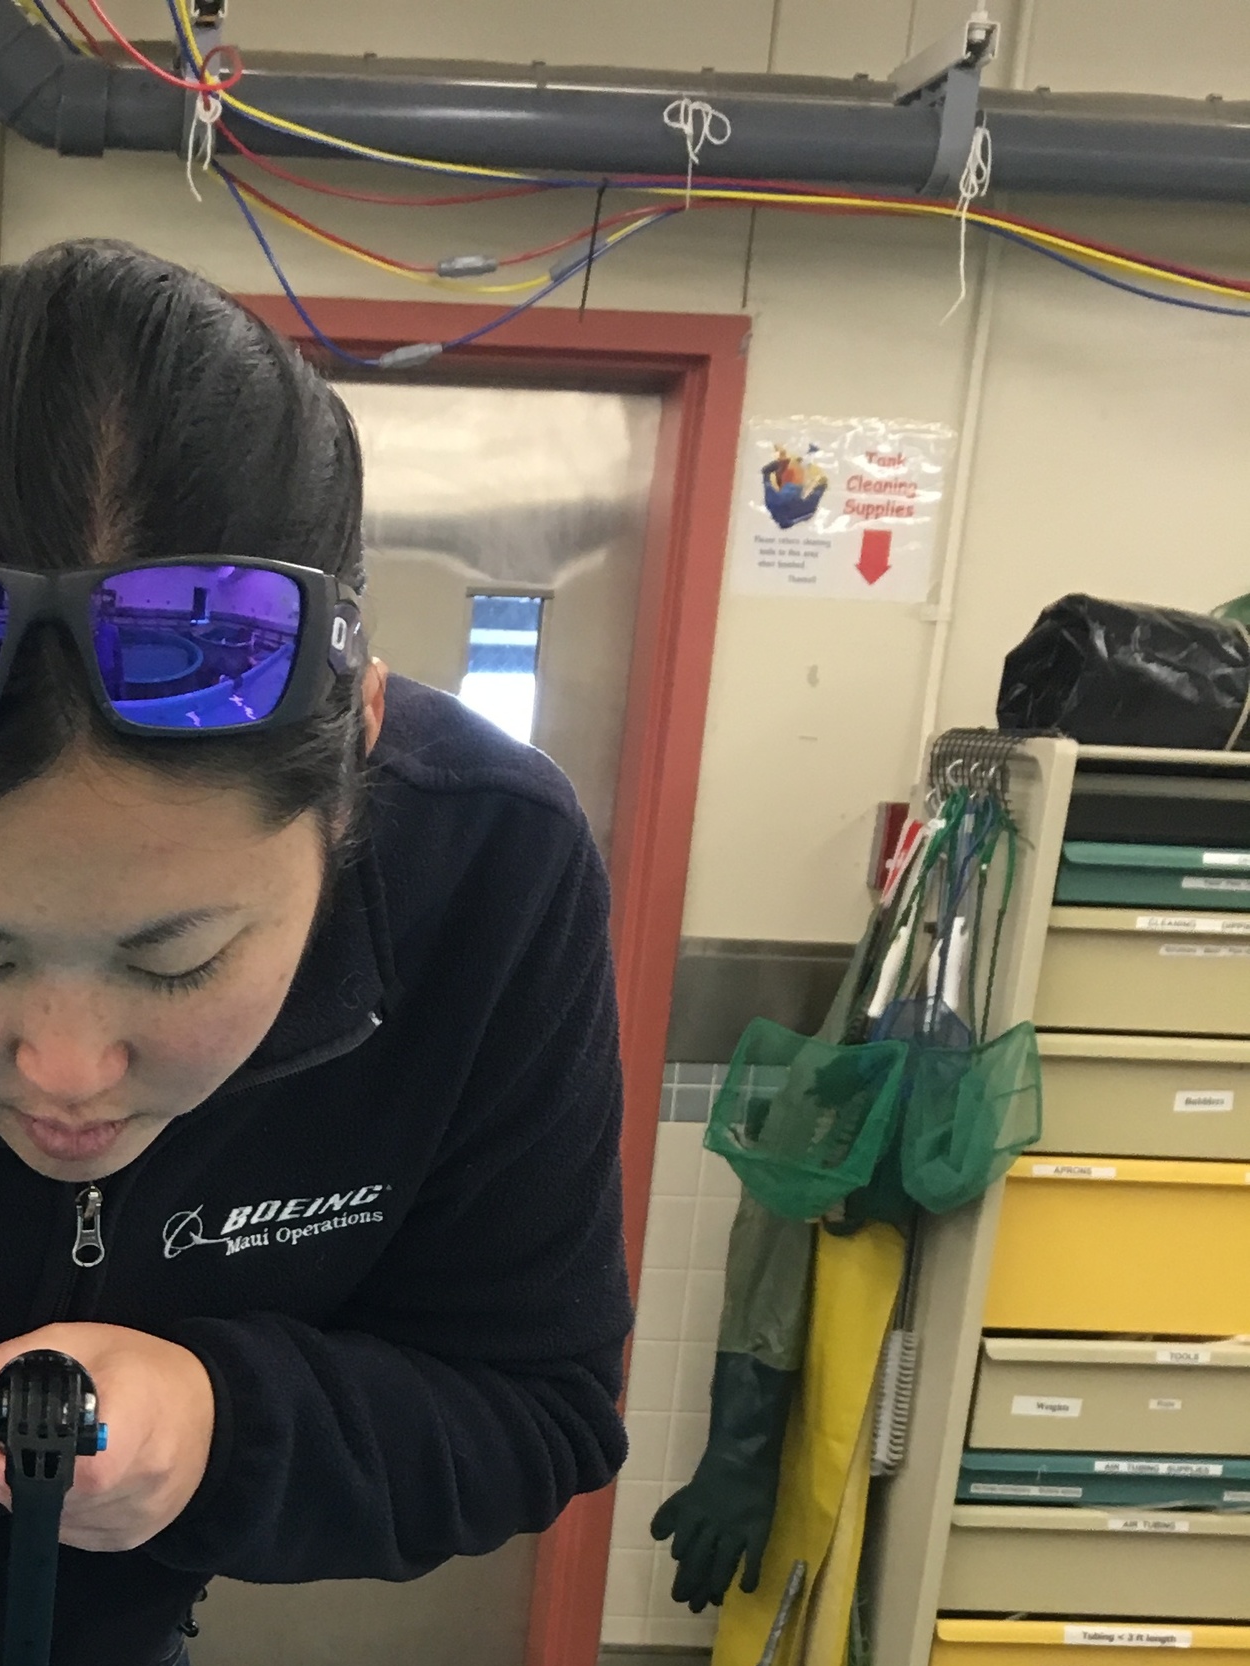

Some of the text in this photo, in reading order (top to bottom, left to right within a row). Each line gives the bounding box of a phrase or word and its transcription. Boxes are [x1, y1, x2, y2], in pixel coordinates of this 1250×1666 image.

[865, 450, 906, 468] Tank
[846, 475, 917, 498] Cleaning
[843, 499, 914, 519] Supplies
[1054, 1166, 1092, 1175] APRONS
[221, 1184, 383, 1235] BOEING
[225, 1211, 384, 1256] Maui Operations
[1169, 1352, 1200, 1361] TOOLS
[1082, 1632, 1115, 1642] Tubing
[1146, 1634, 1176, 1644] length
